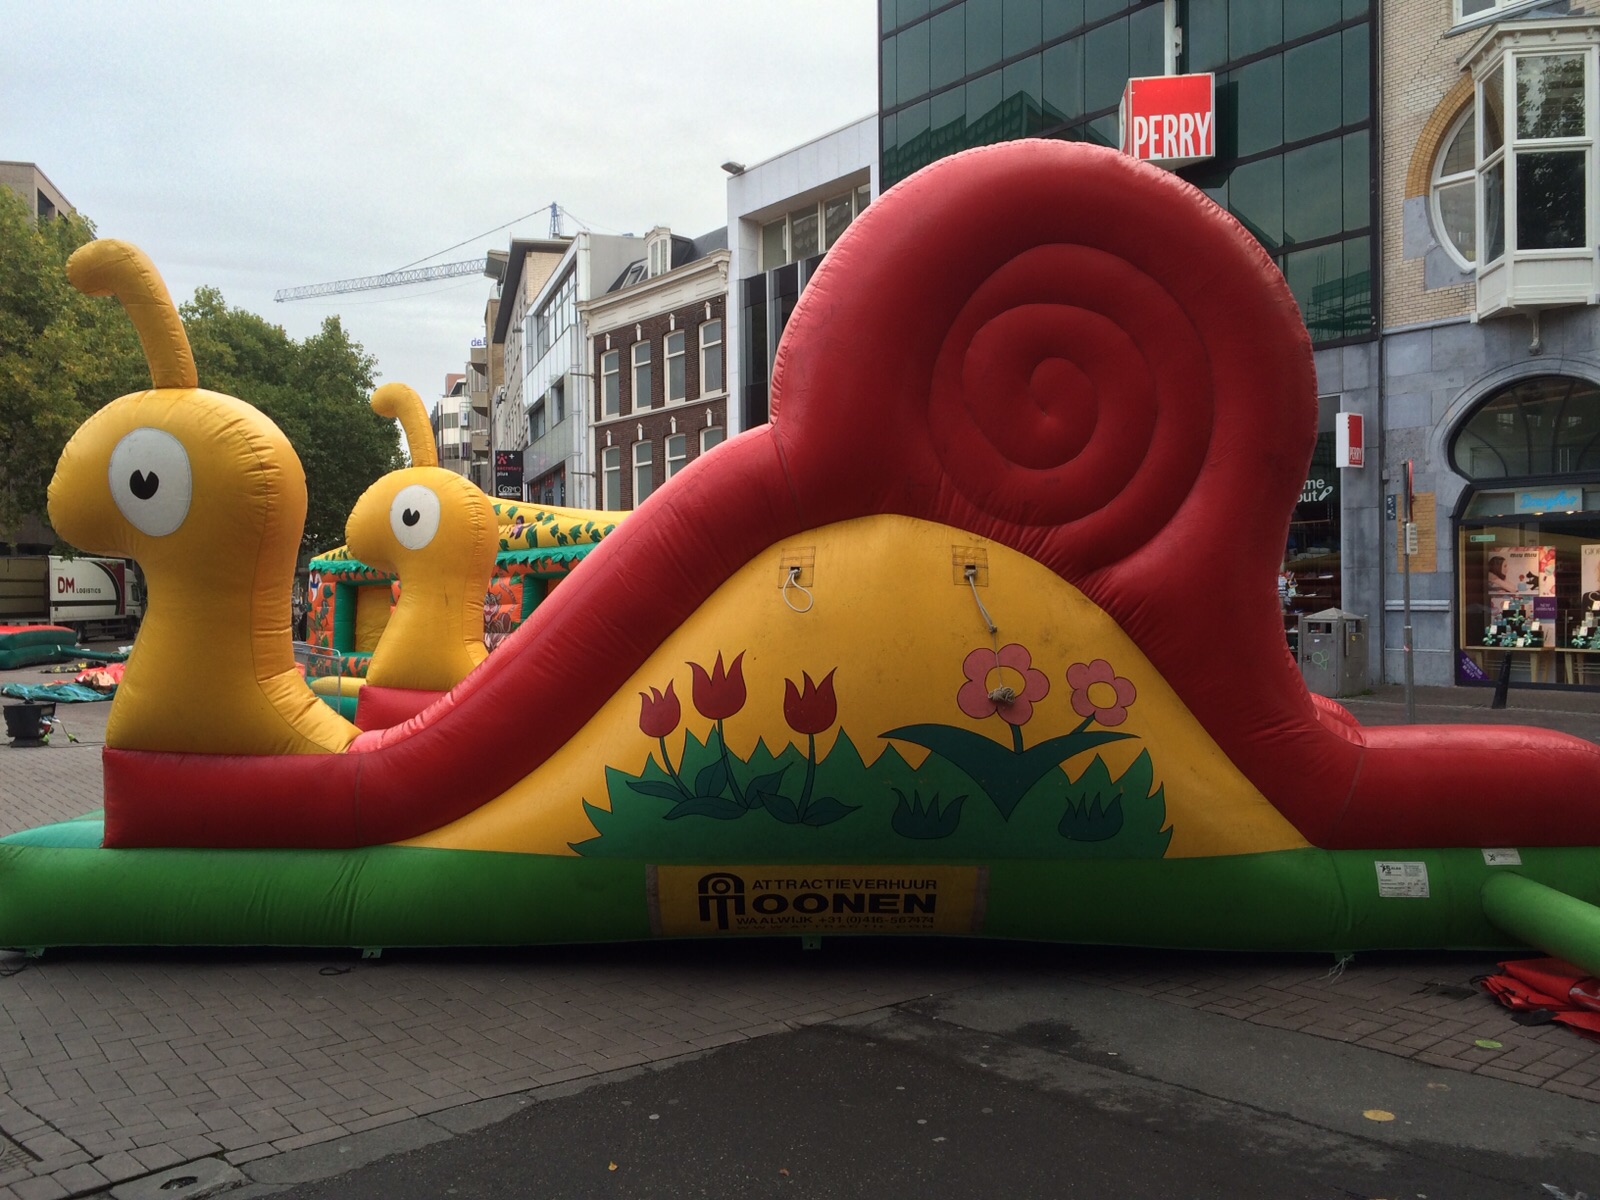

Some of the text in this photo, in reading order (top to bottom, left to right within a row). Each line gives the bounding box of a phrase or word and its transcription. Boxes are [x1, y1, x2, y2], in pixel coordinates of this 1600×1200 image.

[1133, 111, 1212, 160] PERRY
[1349, 446, 1362, 460] PERRY
[58, 576, 75, 593] DM
[752, 879, 937, 890] ATTRACTIEVERHUUR
[736, 916, 813, 925] WAALWIJK
[819, 916, 841, 924] +31
